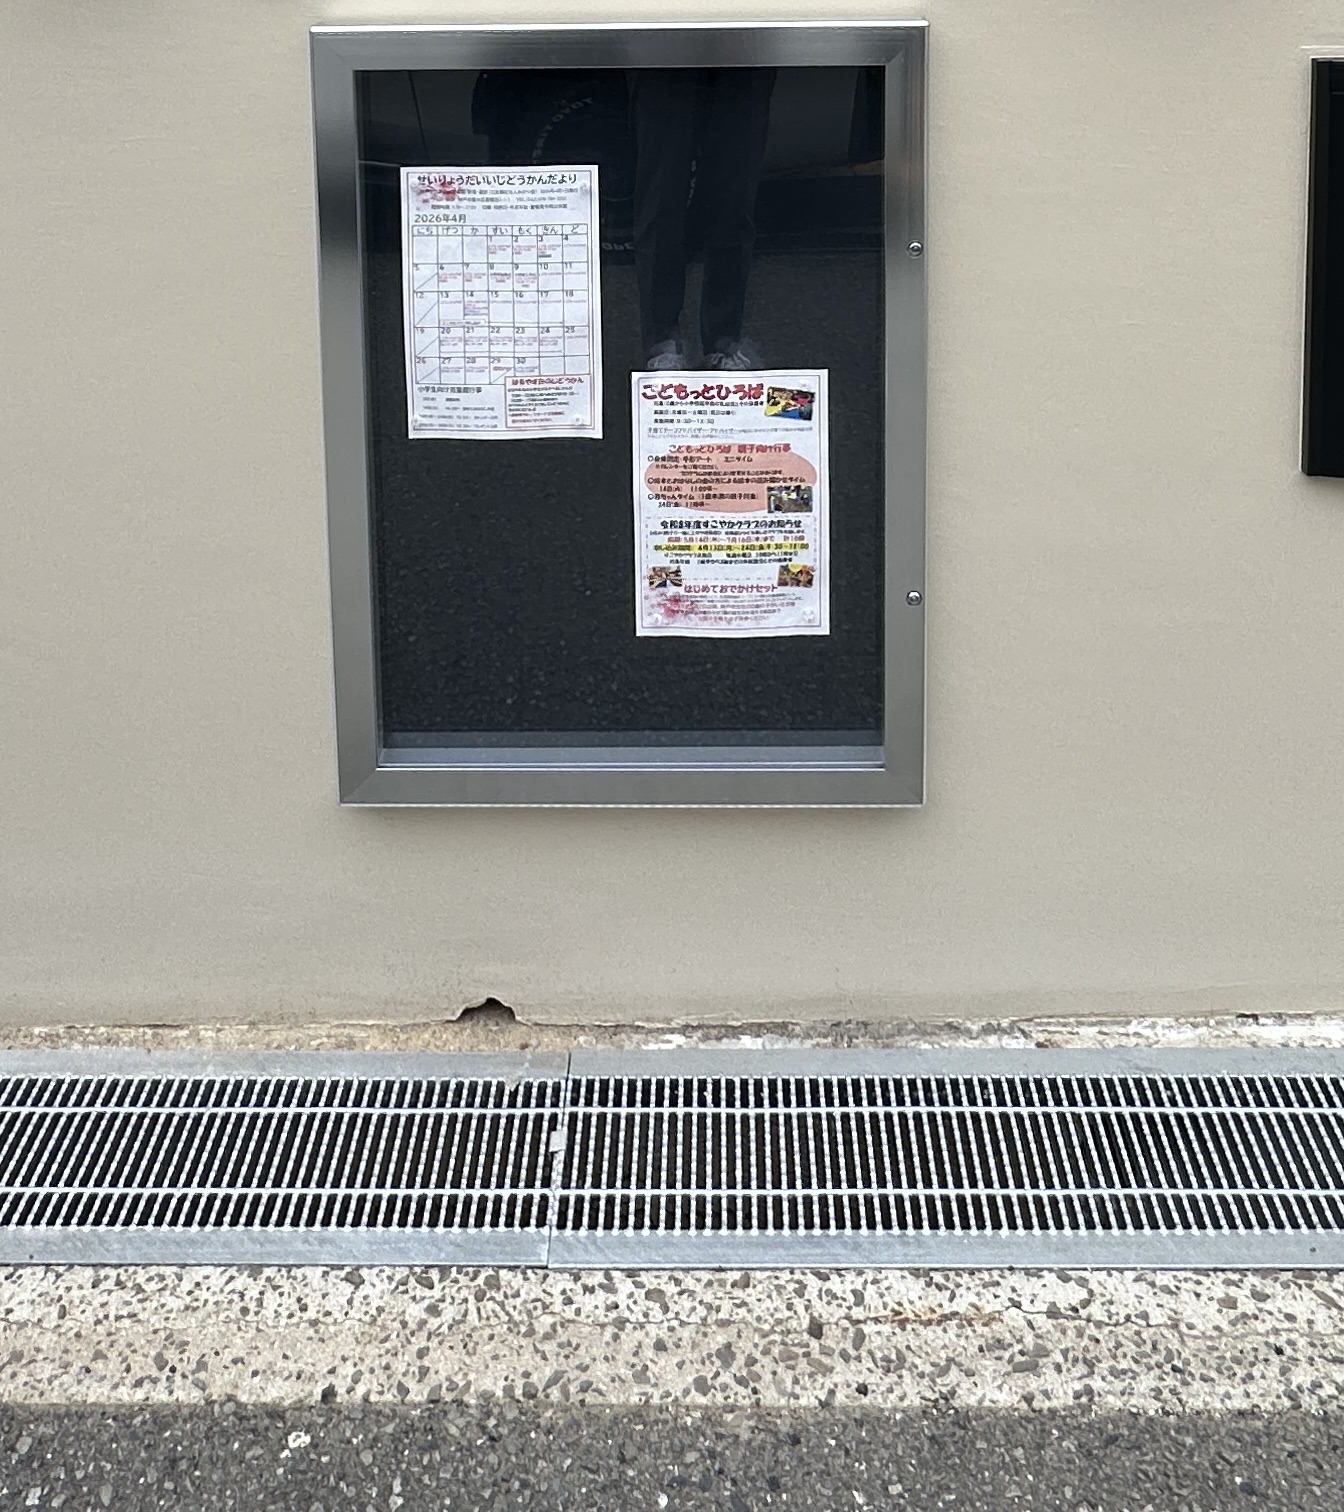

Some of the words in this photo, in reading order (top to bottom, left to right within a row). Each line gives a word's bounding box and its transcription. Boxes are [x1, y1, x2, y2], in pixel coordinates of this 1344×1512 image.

[414, 213, 467, 224] 2026年4月
[641, 383, 764, 400] こどもっとひろば
[669, 444, 731, 454] こどもっとひろば
